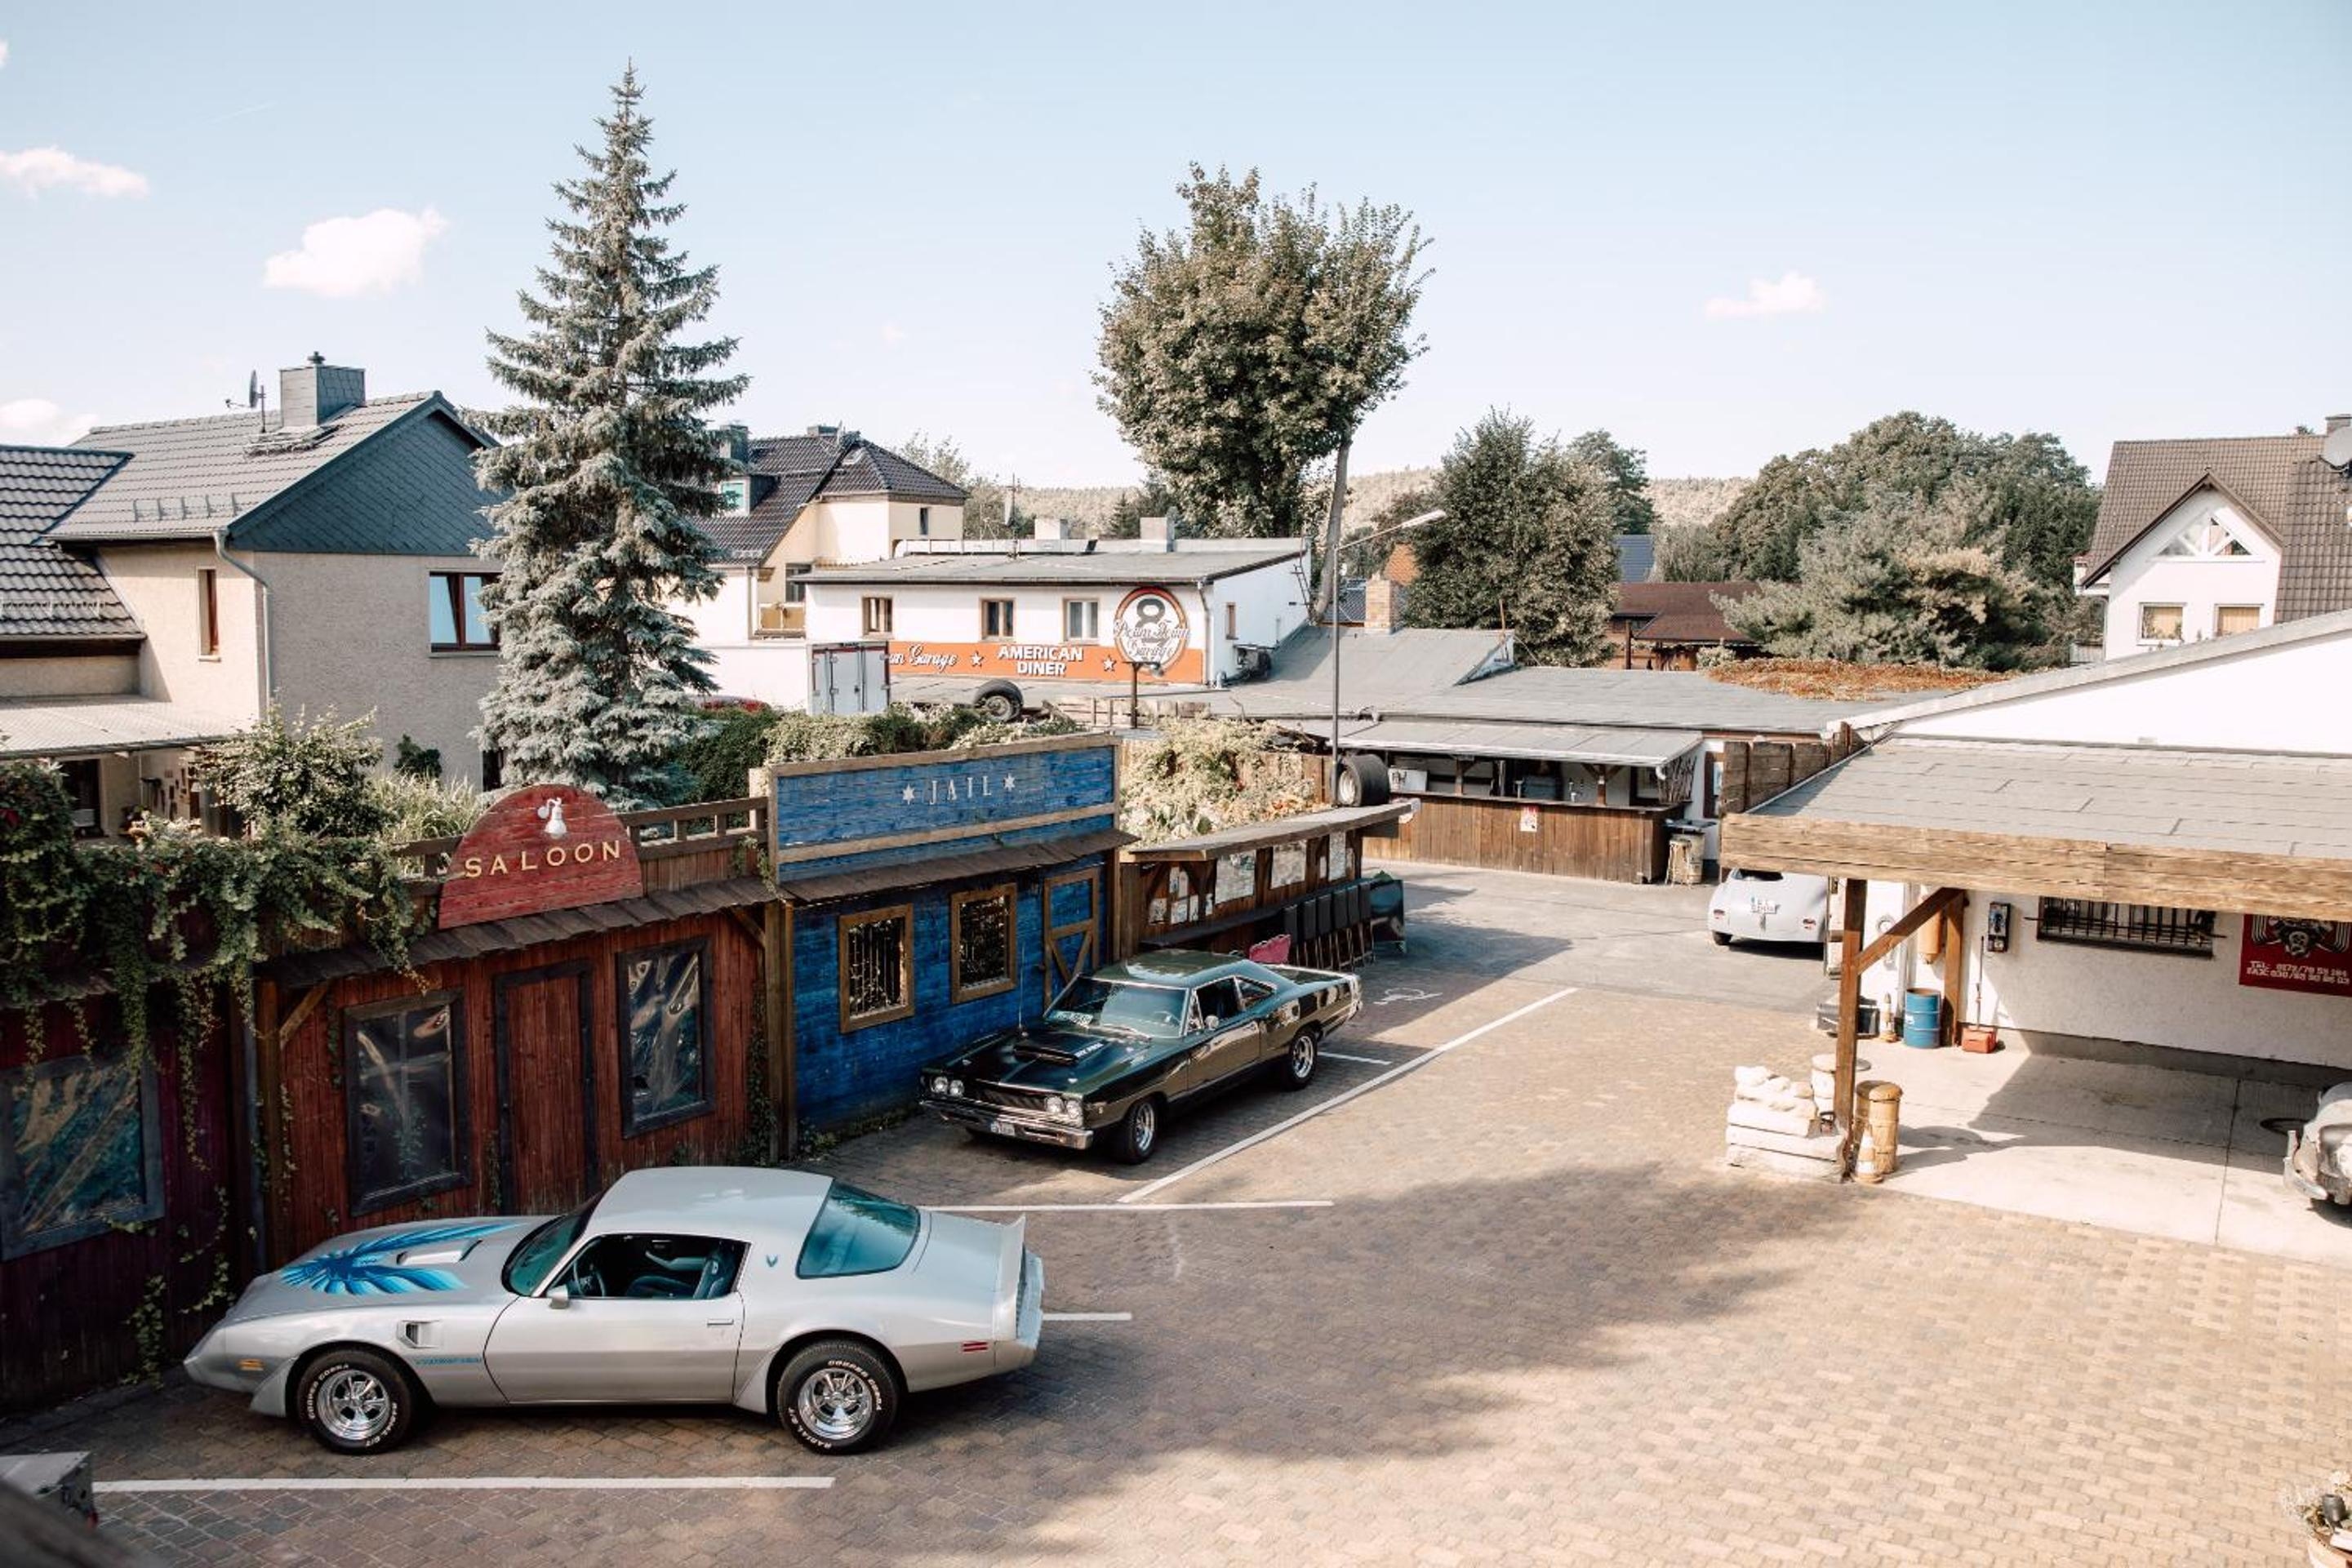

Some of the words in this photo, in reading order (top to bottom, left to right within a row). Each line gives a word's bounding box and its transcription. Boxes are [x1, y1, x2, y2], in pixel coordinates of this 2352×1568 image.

[909, 645, 958, 673] Garage
[997, 644, 1084, 662] AMERICAN
[1016, 660, 1066, 677] DINER
[928, 775, 993, 806] JAIL
[464, 839, 621, 878] SALOON
